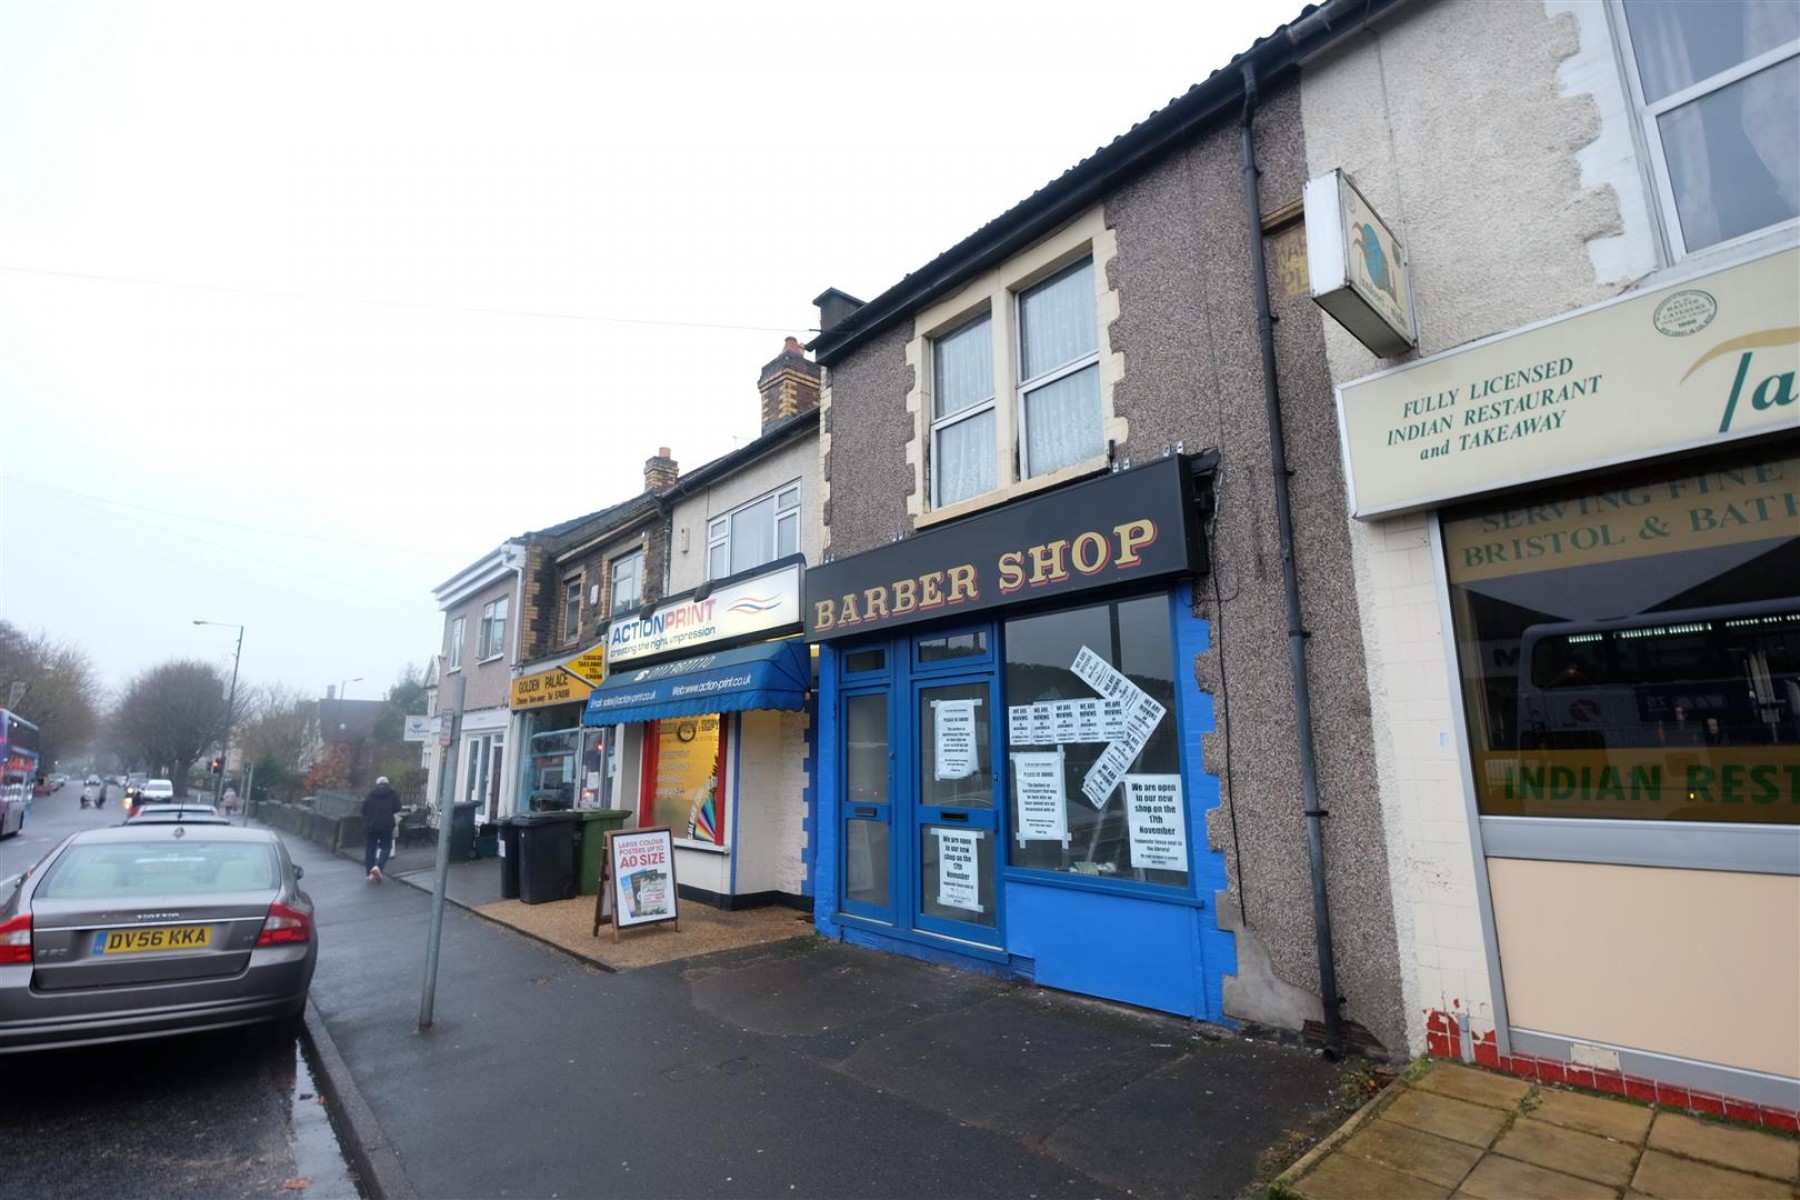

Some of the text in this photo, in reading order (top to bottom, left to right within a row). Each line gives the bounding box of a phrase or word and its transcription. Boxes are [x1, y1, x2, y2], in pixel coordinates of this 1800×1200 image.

[1403, 357, 1574, 418] FULLY LICENSED
[1387, 374, 1603, 447] INDIAN RESTAURANT
[1420, 410, 1566, 460] and TAKEAWAY
[1483, 462, 1784, 533] SERVING FINE
[1464, 522, 1626, 568] BRISTOL
[1638, 515, 1671, 541] &
[814, 518, 1159, 631] BARBER SHOP
[519, 673, 568, 694] GOLDEN PALACE
[1131, 783, 1143, 791] We
[1158, 784, 1177, 792] open
[1503, 763, 1662, 801] INDIAN
[1135, 805, 1152, 813] shop
[1164, 805, 1176, 813] the
[1149, 815, 1163, 823] 17th
[1139, 826, 1175, 835] November
[640, 852, 666, 867] SIZE
[108, 928, 206, 950] DV56 KKA
